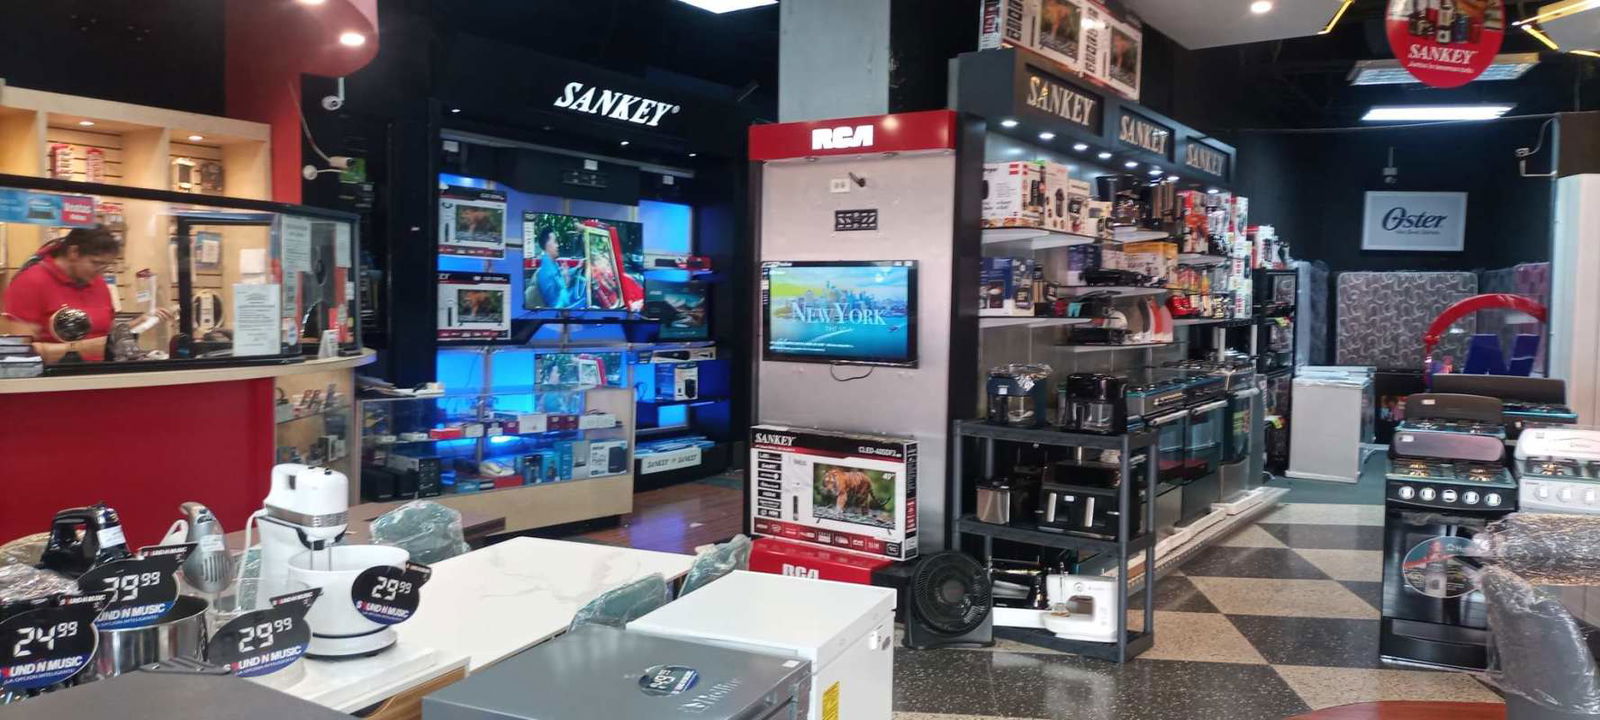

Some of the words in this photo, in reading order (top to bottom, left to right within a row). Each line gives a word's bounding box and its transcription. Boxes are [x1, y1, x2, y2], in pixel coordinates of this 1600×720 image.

[1408, 44, 1479, 65] SANKEY
[1027, 75, 1097, 126] SANKEY
[811, 124, 874, 151] RCA
[1119, 115, 1169, 155] SANKEY
[1187, 143, 1225, 177] SANKEY
[1382, 207, 1449, 231] Oster
[755, 432, 797, 447] SANKEY
[782, 563, 819, 579] RCA
[371, 576, 399, 601] 29
[131, 603, 166, 617] MUSIC
[14, 625, 57, 658] 24
[57, 621, 78, 638] 99
[238, 622, 273, 653] 29
[274, 617, 292, 633] 99
[36, 661, 48, 673] N
[48, 656, 83, 673] MUSIC
[261, 654, 271, 664] N
[270, 645, 302, 661] MUSIC
